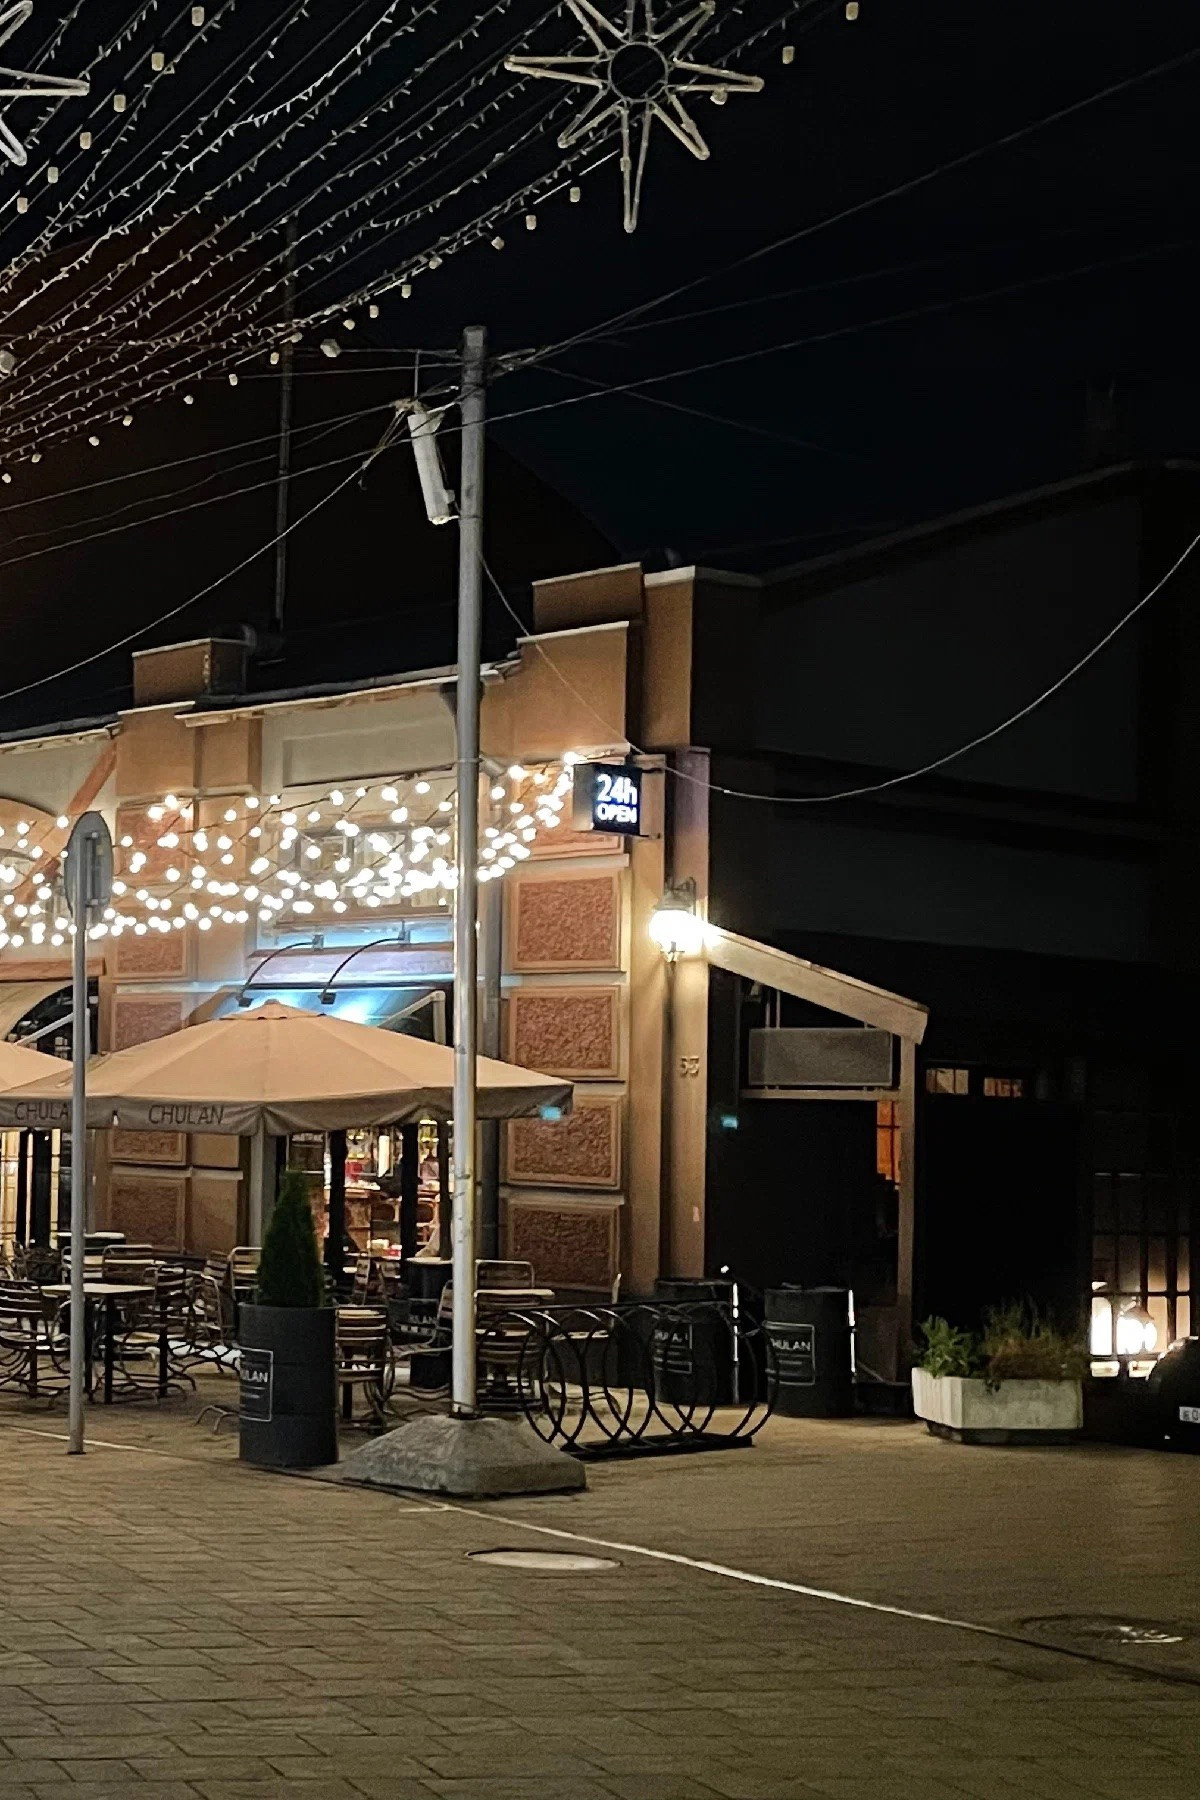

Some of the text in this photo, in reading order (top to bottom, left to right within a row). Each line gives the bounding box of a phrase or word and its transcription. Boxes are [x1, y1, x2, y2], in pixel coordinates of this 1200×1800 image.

[596, 773, 639, 806] 24h
[596, 803, 639, 824] OPEN
[14, 1101, 73, 1121] CHULA
[148, 1104, 225, 1125] CHULAN
[770, 1337, 811, 1351] HULAN
